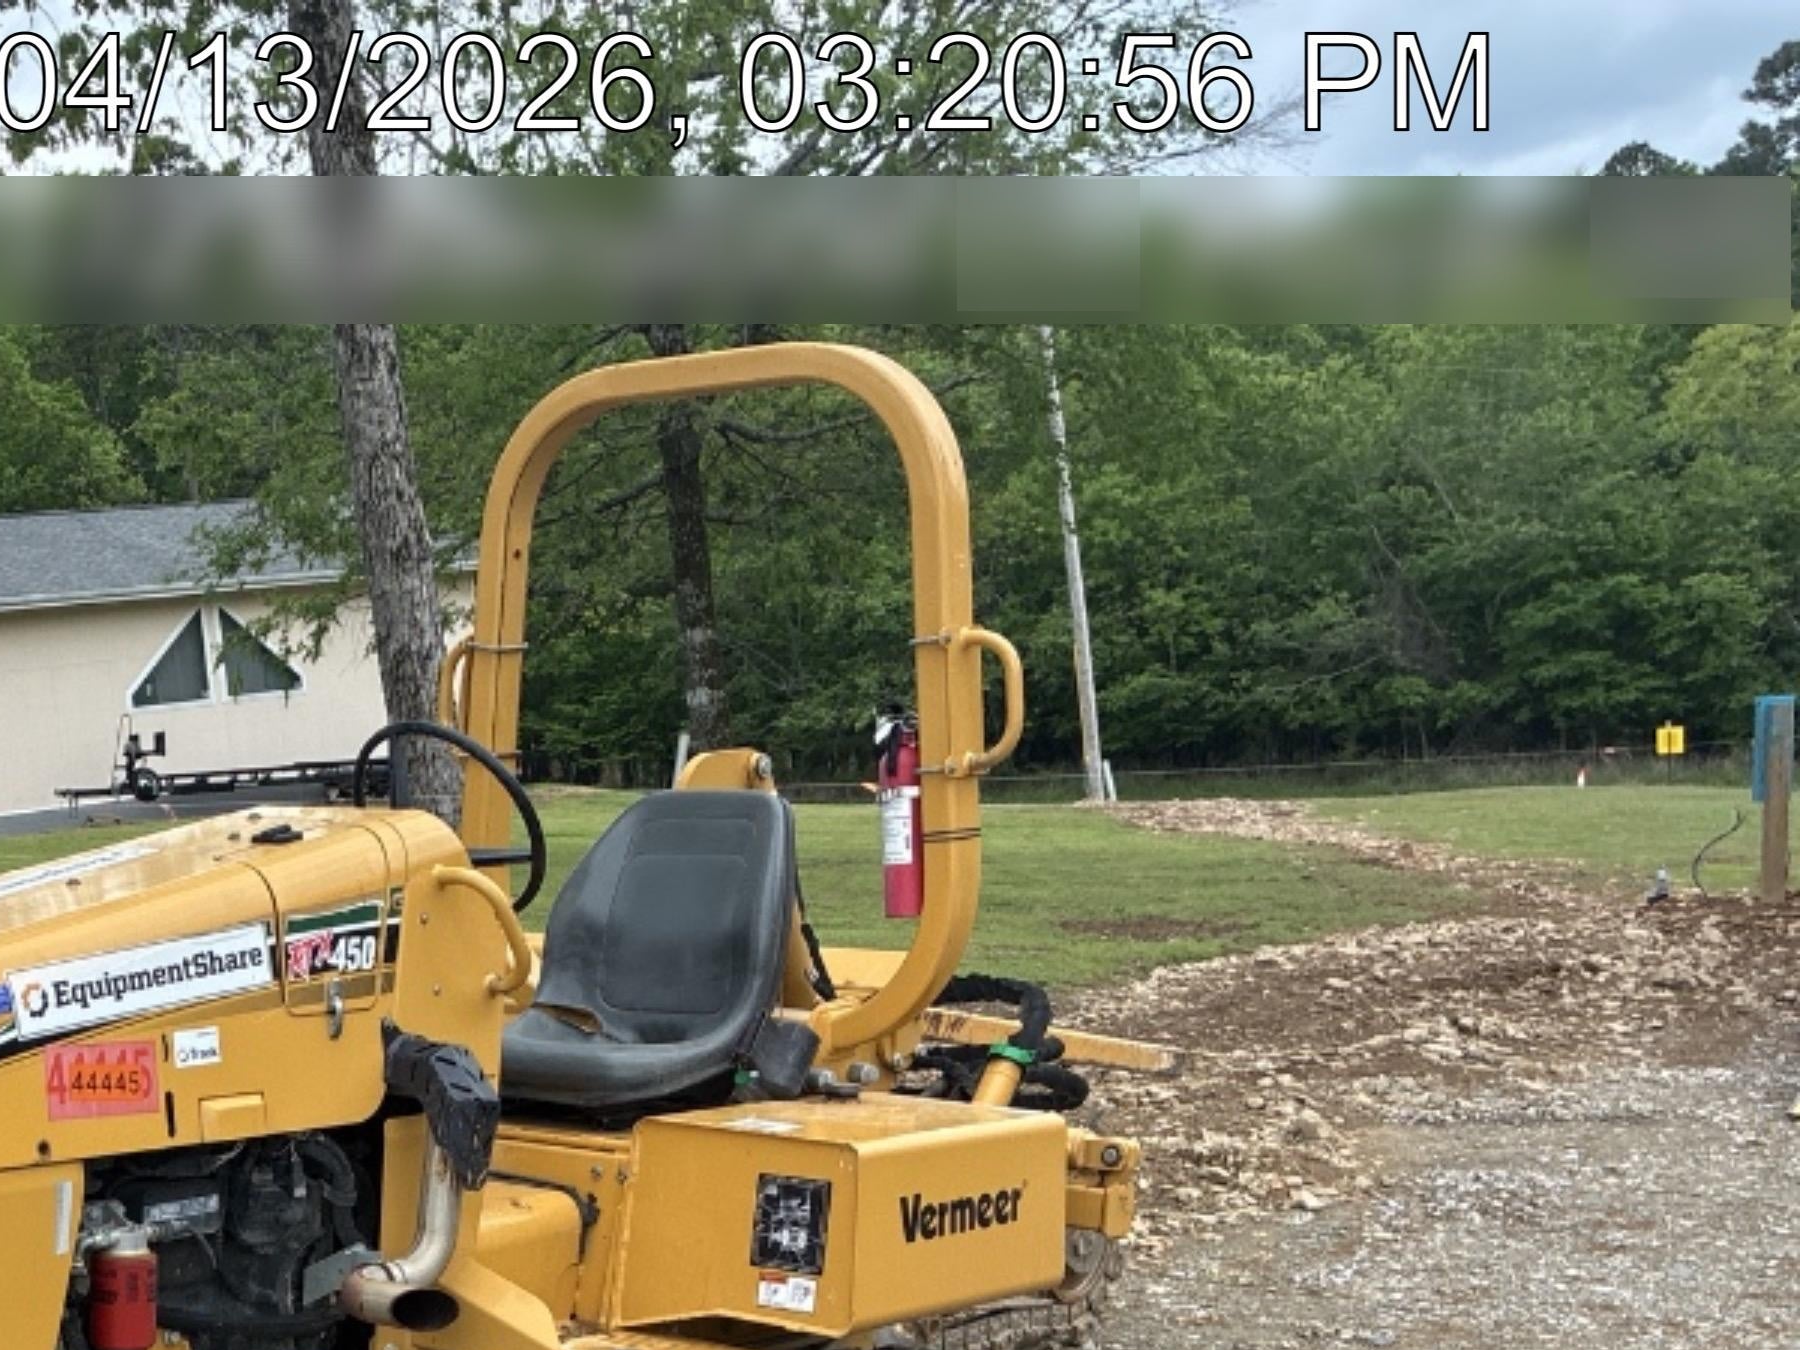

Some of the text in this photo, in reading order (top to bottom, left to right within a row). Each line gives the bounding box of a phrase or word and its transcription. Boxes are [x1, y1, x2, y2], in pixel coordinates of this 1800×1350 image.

[52, 946, 264, 1009] EquipmentShare
[71, 1070, 140, 1096] 44445
[899, 1187, 1022, 1243] Vermeer
